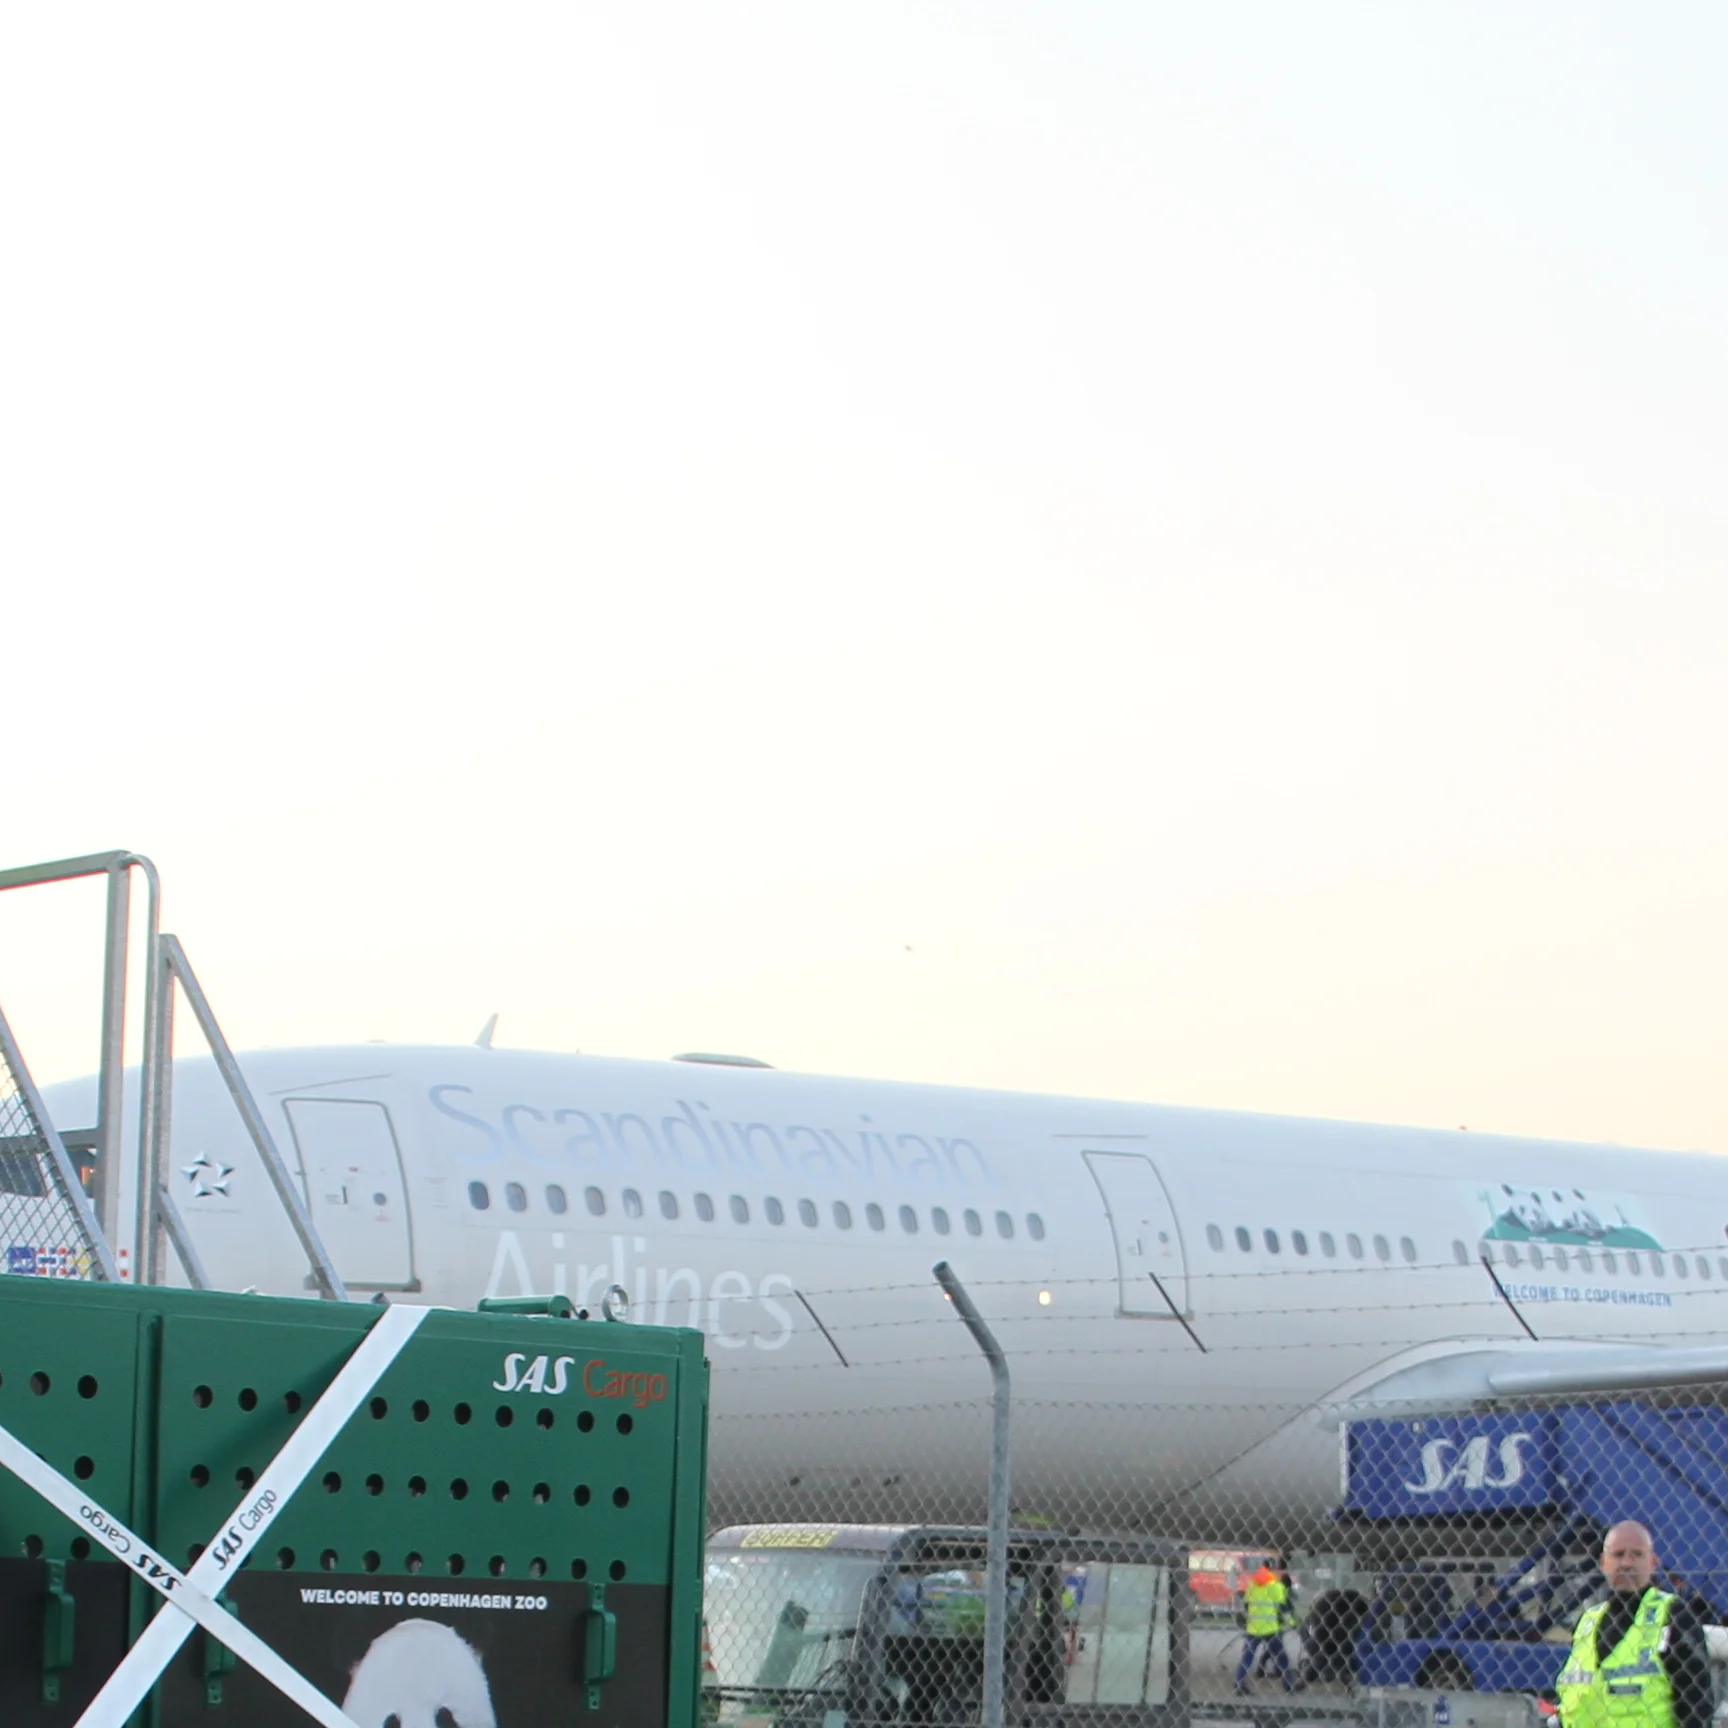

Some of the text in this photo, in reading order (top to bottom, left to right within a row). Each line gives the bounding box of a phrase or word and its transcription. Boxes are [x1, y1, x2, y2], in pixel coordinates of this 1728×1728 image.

[427, 1081, 997, 1192] Scandinavian
[482, 1229, 795, 1353] Airlines
[1562, 1286, 1580, 1302] TO
[1584, 1287, 1672, 1308] COPENHAGEN
[492, 1352, 668, 1408] SAS Cargo
[1404, 1432, 1532, 1494] SAS
[78, 1504, 182, 1591] SAS Cargo
[211, 1489, 278, 1571] SAS Cargo
[300, 1588, 548, 1610] WELCOME TO COPENHAGEN ZOO
